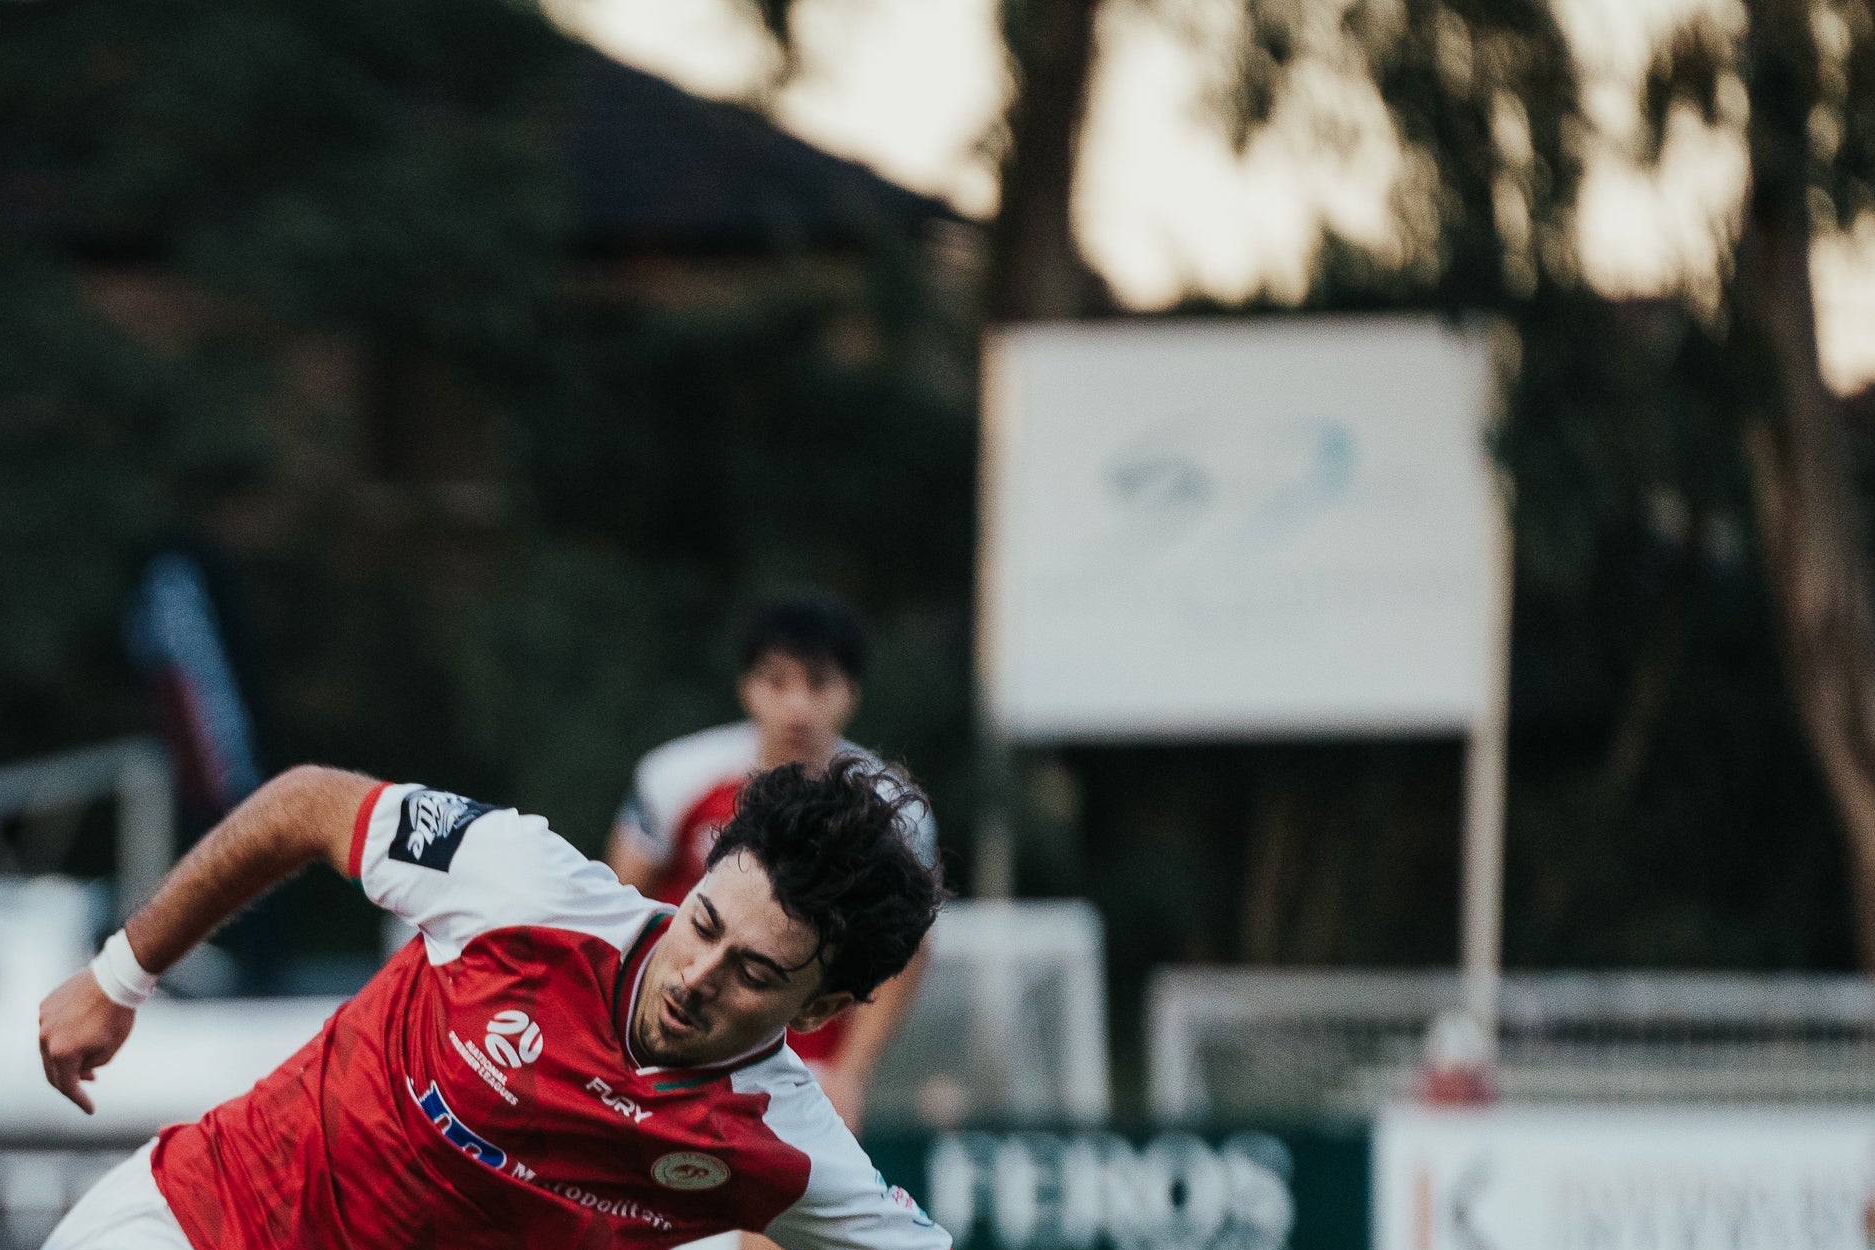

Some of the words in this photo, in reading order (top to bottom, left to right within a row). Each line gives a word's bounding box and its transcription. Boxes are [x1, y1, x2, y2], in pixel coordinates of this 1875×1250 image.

[465, 1039, 507, 1086] NATIONAL
[477, 1065, 519, 1106] LEAGUES
[586, 1076, 654, 1124] FURY
[511, 1161, 673, 1231] Mropolitan
